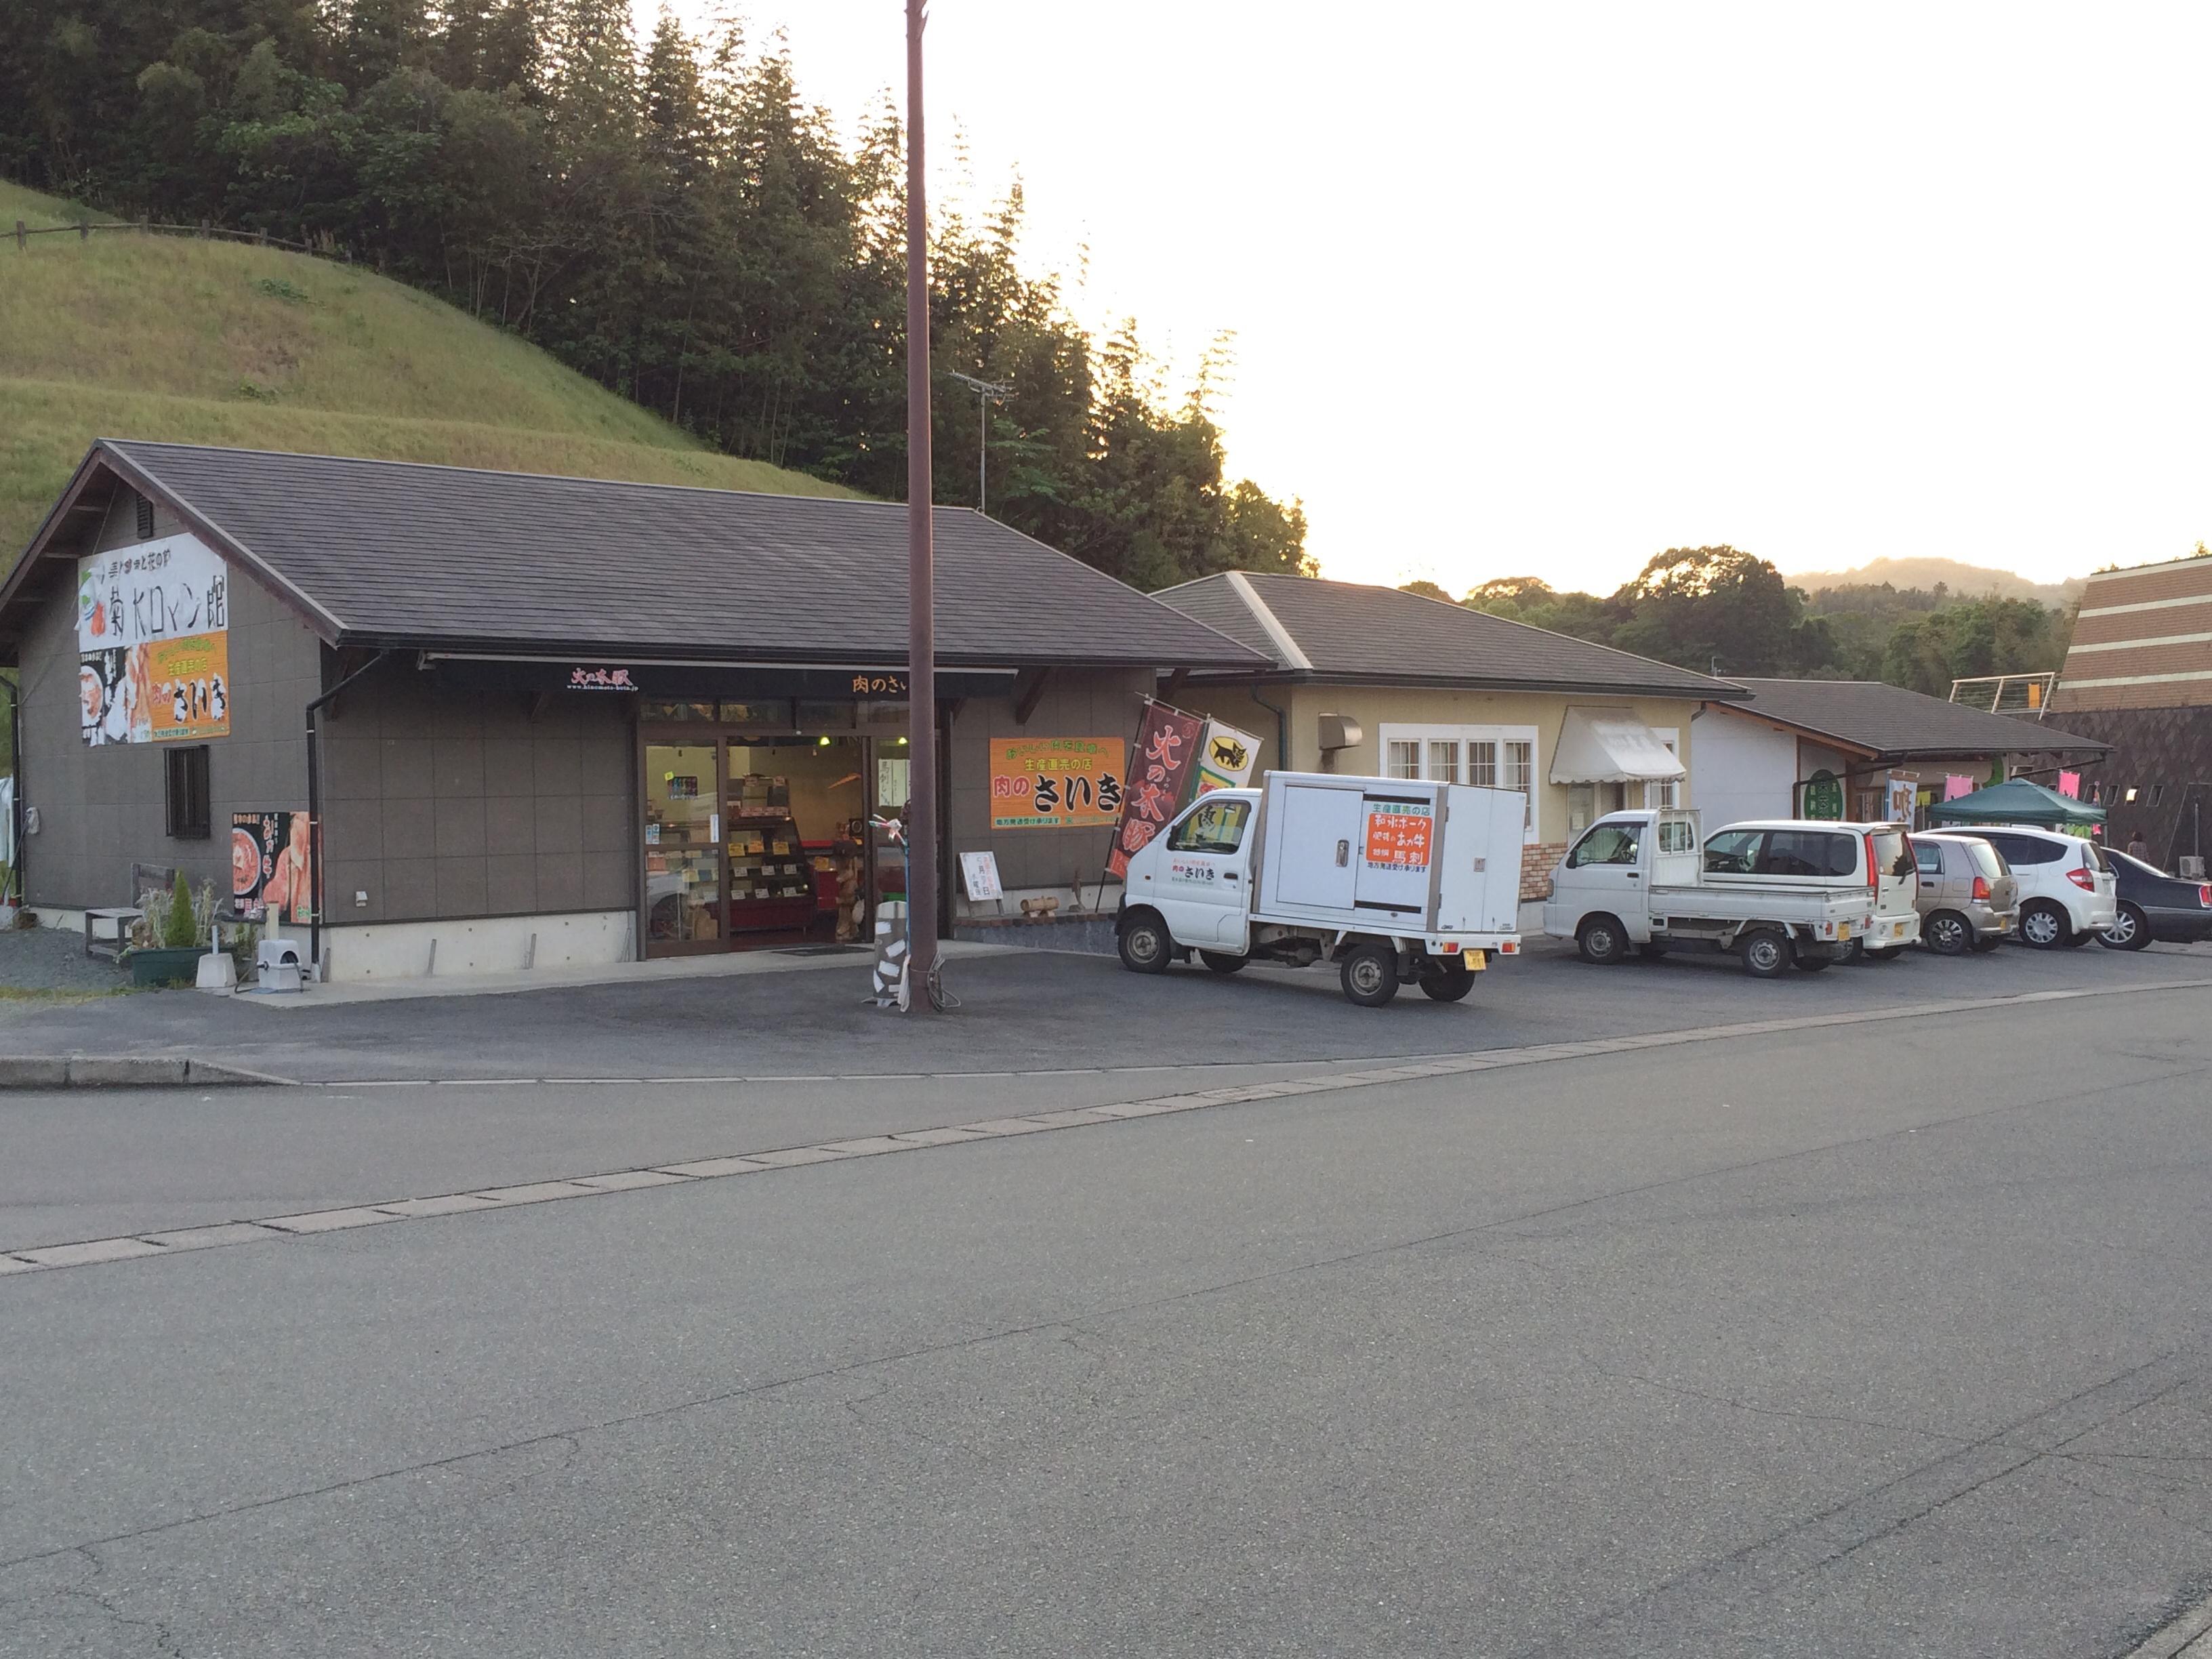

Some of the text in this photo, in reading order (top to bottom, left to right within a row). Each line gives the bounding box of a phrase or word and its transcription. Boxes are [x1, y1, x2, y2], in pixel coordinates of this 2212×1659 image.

[852, 674, 909, 693] 肉のさい
[1025, 758, 1092, 771] 生産直売の店
[994, 772, 1122, 813] 肉のさいき
[1122, 725, 1182, 853] 火の本豚
[1373, 804, 1431, 816] 生産直売の店
[996, 817, 1059, 826] 地方発送受け承ります
[1392, 850, 1424, 865] 馬刺
[1172, 864, 1214, 881] 肉のさいき
